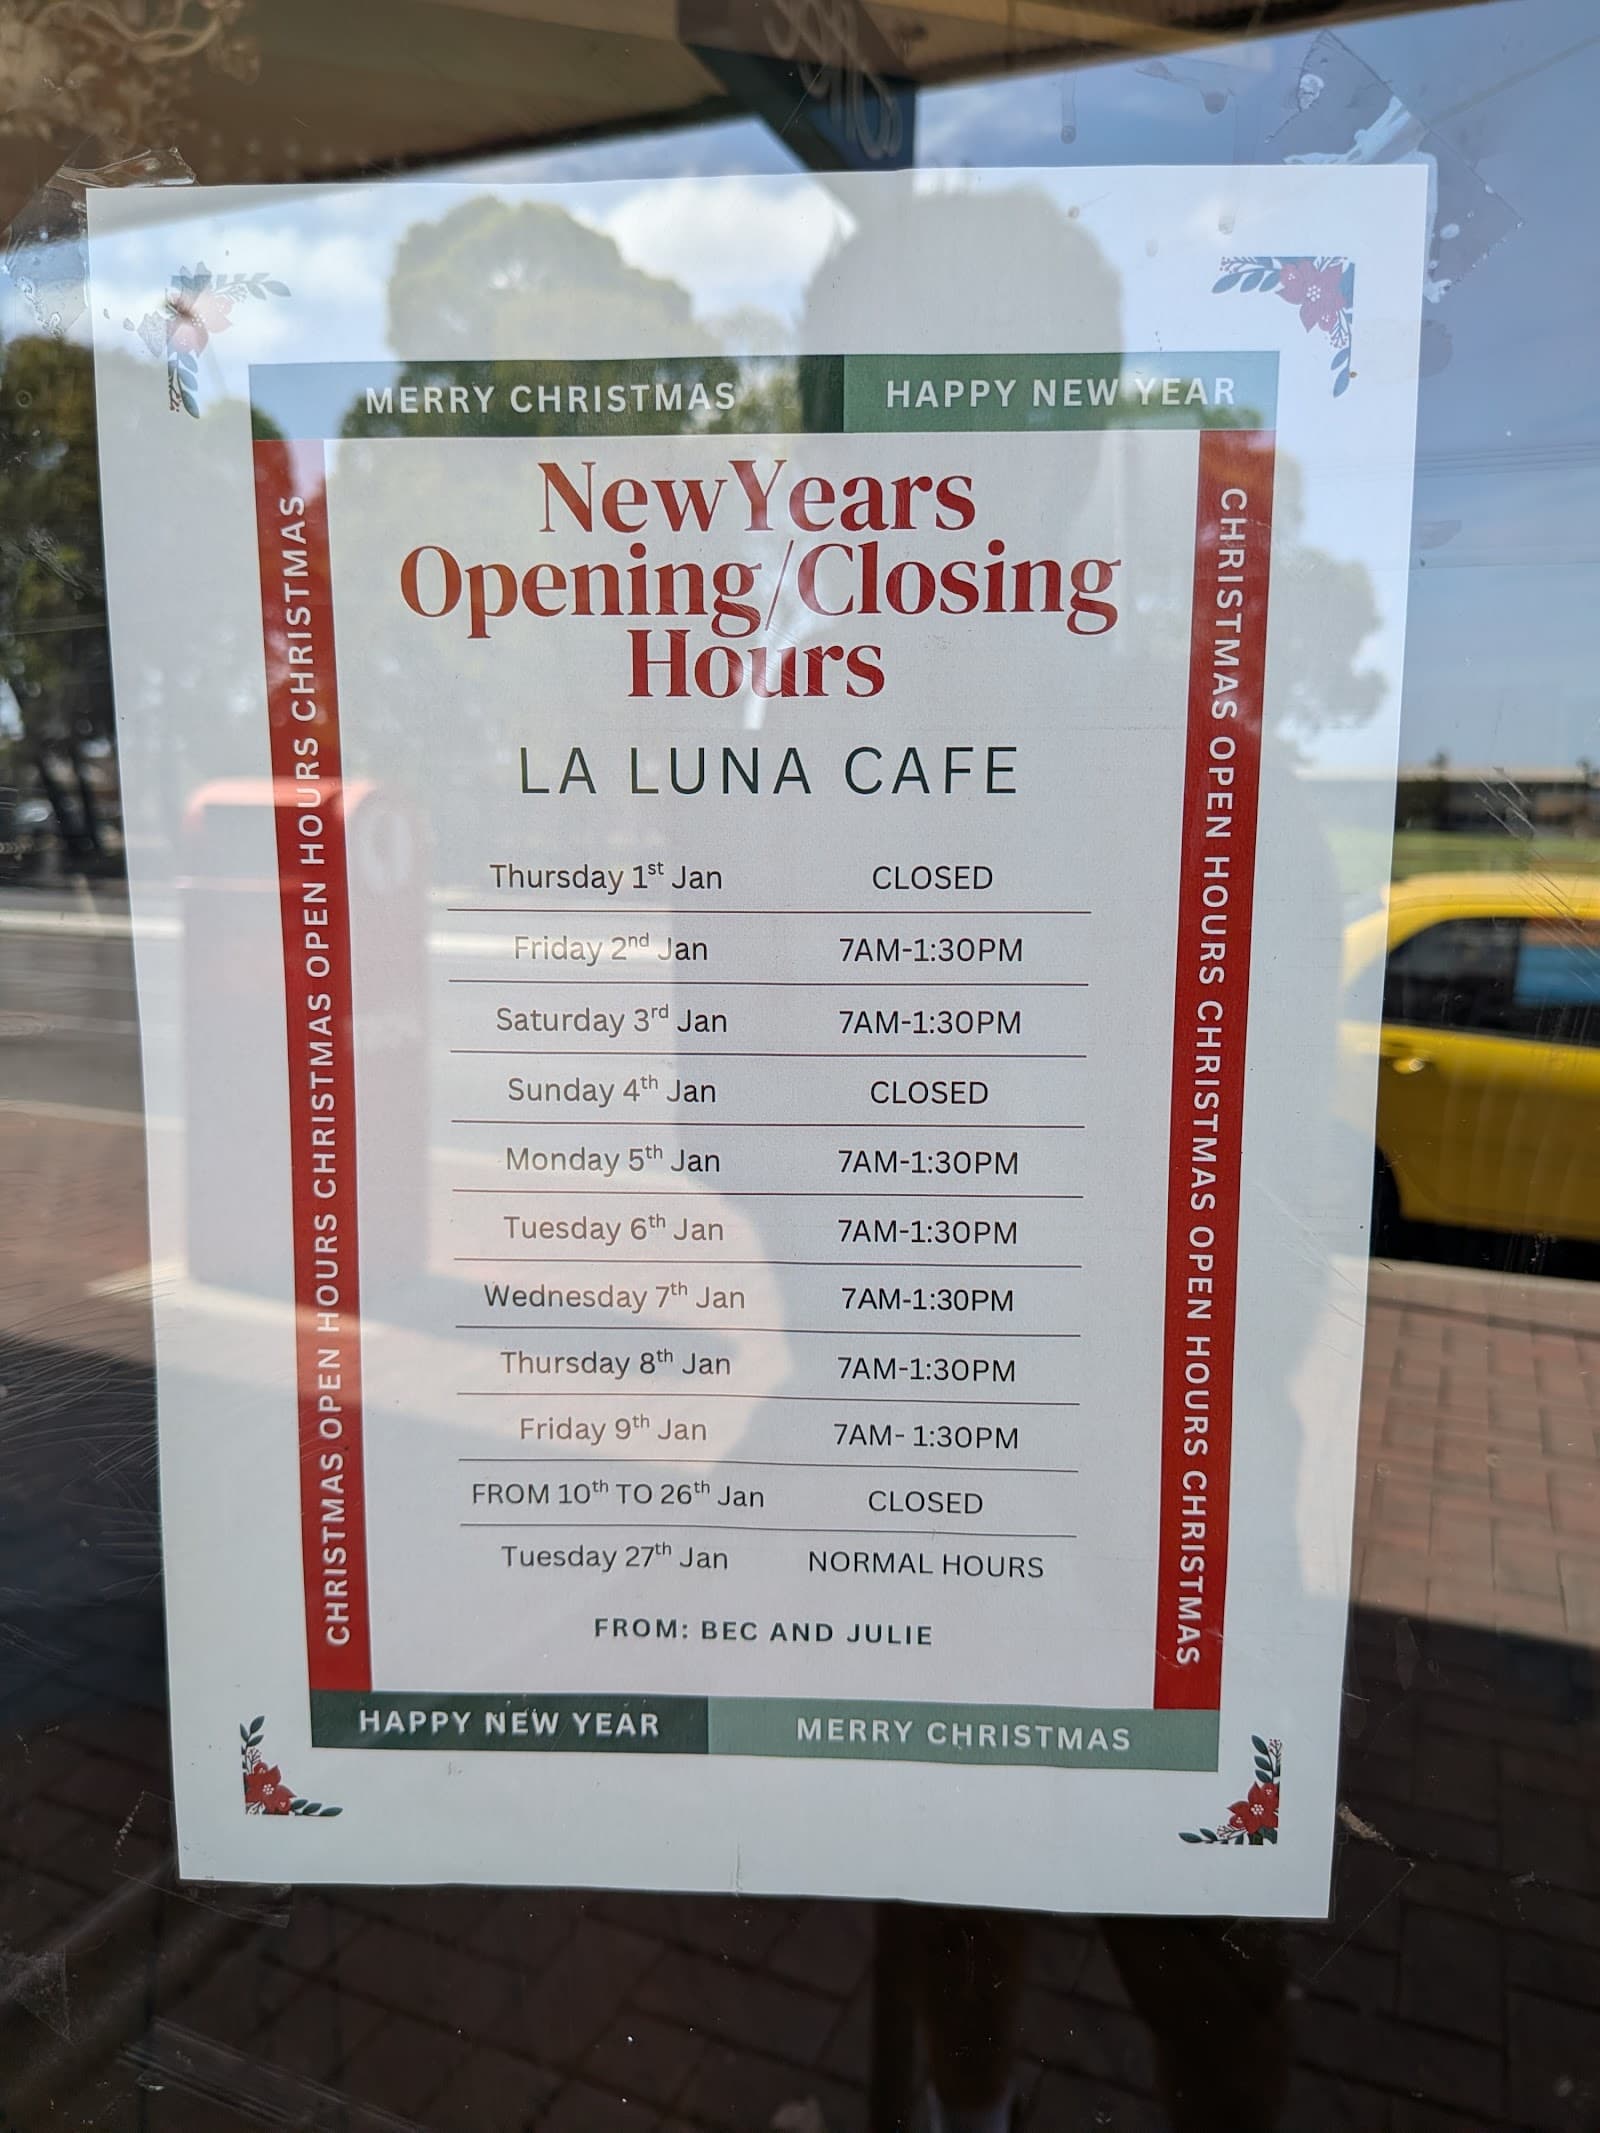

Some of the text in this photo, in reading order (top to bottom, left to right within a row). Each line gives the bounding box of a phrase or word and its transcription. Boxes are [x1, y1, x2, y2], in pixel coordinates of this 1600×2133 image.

[365, 382, 736, 414] MERRY CHRISTMAS
[886, 377, 1235, 408] HAPPY NEW YEAR
[400, 539, 1122, 639] Opening/Closing
[627, 628, 886, 698] Hours
[520, 746, 1018, 794] LA LUNA CAFE
[490, 861, 723, 895] Thursday 1st Jan
[872, 866, 993, 891] CLOSED
[514, 933, 709, 966] Friday 2nd Jan
[839, 938, 1023, 963] 7AM-1:30PM
[496, 1004, 728, 1037] Saturday 3rd Jan
[839, 1010, 1022, 1035] 7AM-1:30PM
[279, 496, 350, 1645] CHRISTMAS OPEN HOURS CHRISTMAS OPEN HOURS CHRISTMAS
[1176, 488, 1248, 1664] CHRISTMAS OPEN HOURS CHRISTMAS OPEN HOURS CHRISTMAS
[507, 1074, 717, 1107] Sunday 4th Jan
[870, 1081, 989, 1105] CLOSED
[506, 1144, 721, 1176] Monday 5th Jan
[838, 1149, 1019, 1175] 7AM-1:30PM
[503, 1213, 725, 1245] Tuesday 6th Jan
[838, 1219, 1018, 1245] 7AM-1:30PM
[484, 1281, 745, 1313] Wednesday 7th Jan
[841, 1287, 1014, 1313] 7AM-1:30PM
[501, 1348, 731, 1380] Thursday 8th Jan
[837, 1357, 1016, 1383] 7AM-1:30PM
[519, 1413, 708, 1446] Friday 9th Jan
[471, 1479, 765, 1509] FROM 10th TO 26th Jan
[868, 1489, 983, 1515] CLOSED
[502, 1542, 728, 1574] Tuesday 27th Jan
[808, 1550, 1044, 1578] NORMAL HOURS
[594, 1618, 933, 1645] FROM: BEC AND JULIE
[359, 1709, 659, 1737] HAPPY NEW YEAR
[797, 1717, 1130, 1751] MERRY CHRISTMAS
